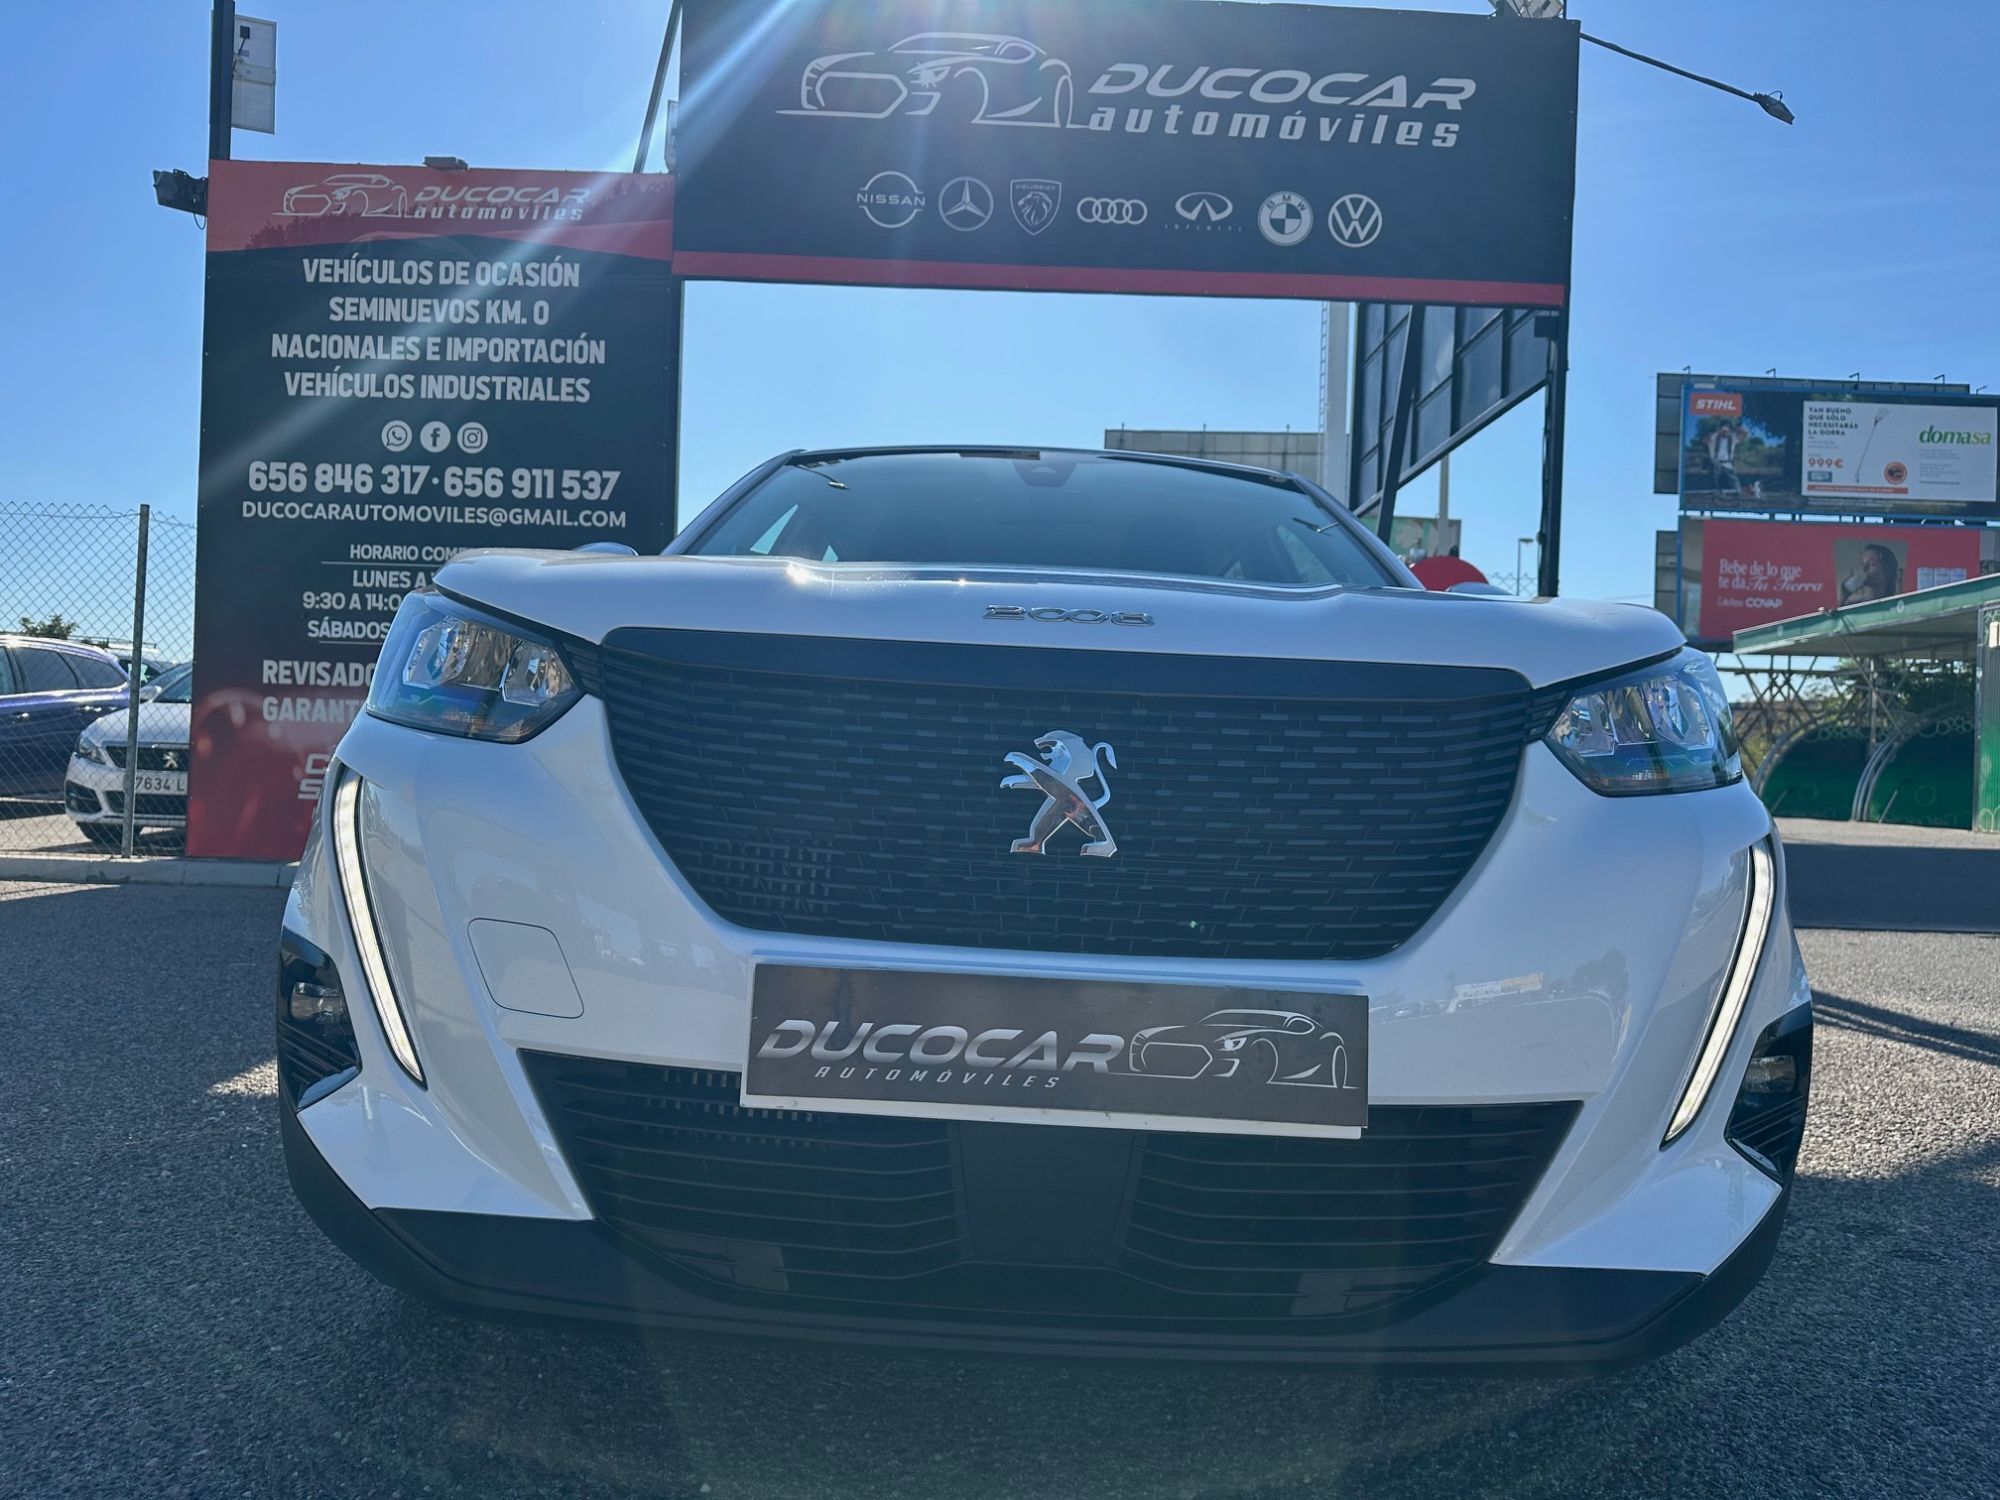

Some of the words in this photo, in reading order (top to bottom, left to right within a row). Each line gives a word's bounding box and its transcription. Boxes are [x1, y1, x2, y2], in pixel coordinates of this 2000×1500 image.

[1088, 61, 1476, 111] DUCOCAR
[1089, 103, 1460, 148] automóviles
[413, 186, 589, 204] DUCOCAR
[857, 193, 925, 206] NISSAN
[414, 204, 583, 221] automóviles
[303, 252, 433, 286] VEHÍCULOS
[439, 261, 470, 286] DE
[475, 256, 580, 287] OCASIÓN
[329, 297, 480, 324] SEMINUEVOS
[485, 300, 527, 325] KM.
[272, 334, 420, 361] NACIONALES
[427, 338, 440, 360] E
[446, 333, 605, 364] IMPORTACIÓN
[284, 366, 415, 399] VEHÍCULOS
[420, 376, 590, 403] INDUSTRIALES
[1695, 399, 1736, 411] STIHL
[1919, 425, 1991, 445] domasa
[1808, 458, 1843, 468] 999€
[248, 461, 306, 492] 656
[315, 463, 373, 494] 846
[511, 469, 554, 498] 911
[562, 470, 620, 500] 537
[243, 501, 626, 528] DUCOCARAUTOMOVILES@GMAIL.COM
[350, 545, 418, 560] HORARIO
[353, 570, 411, 588] LUNES
[415, 572, 426, 588] A
[1720, 559, 1747, 575] Bebe
[1750, 561, 1763, 576] de
[1767, 561, 1778, 576] lo
[1781, 566, 1801, 579] que
[1719, 576, 1729, 588] te
[303, 591, 346, 609] 9:30
[349, 593, 361, 609] A
[1746, 597, 1782, 608] COVAP
[982, 605, 1154, 627] 2008
[757, 1019, 1125, 1073] DUCOCAR
[815, 1065, 1059, 1089] AUTOMÓVILES
